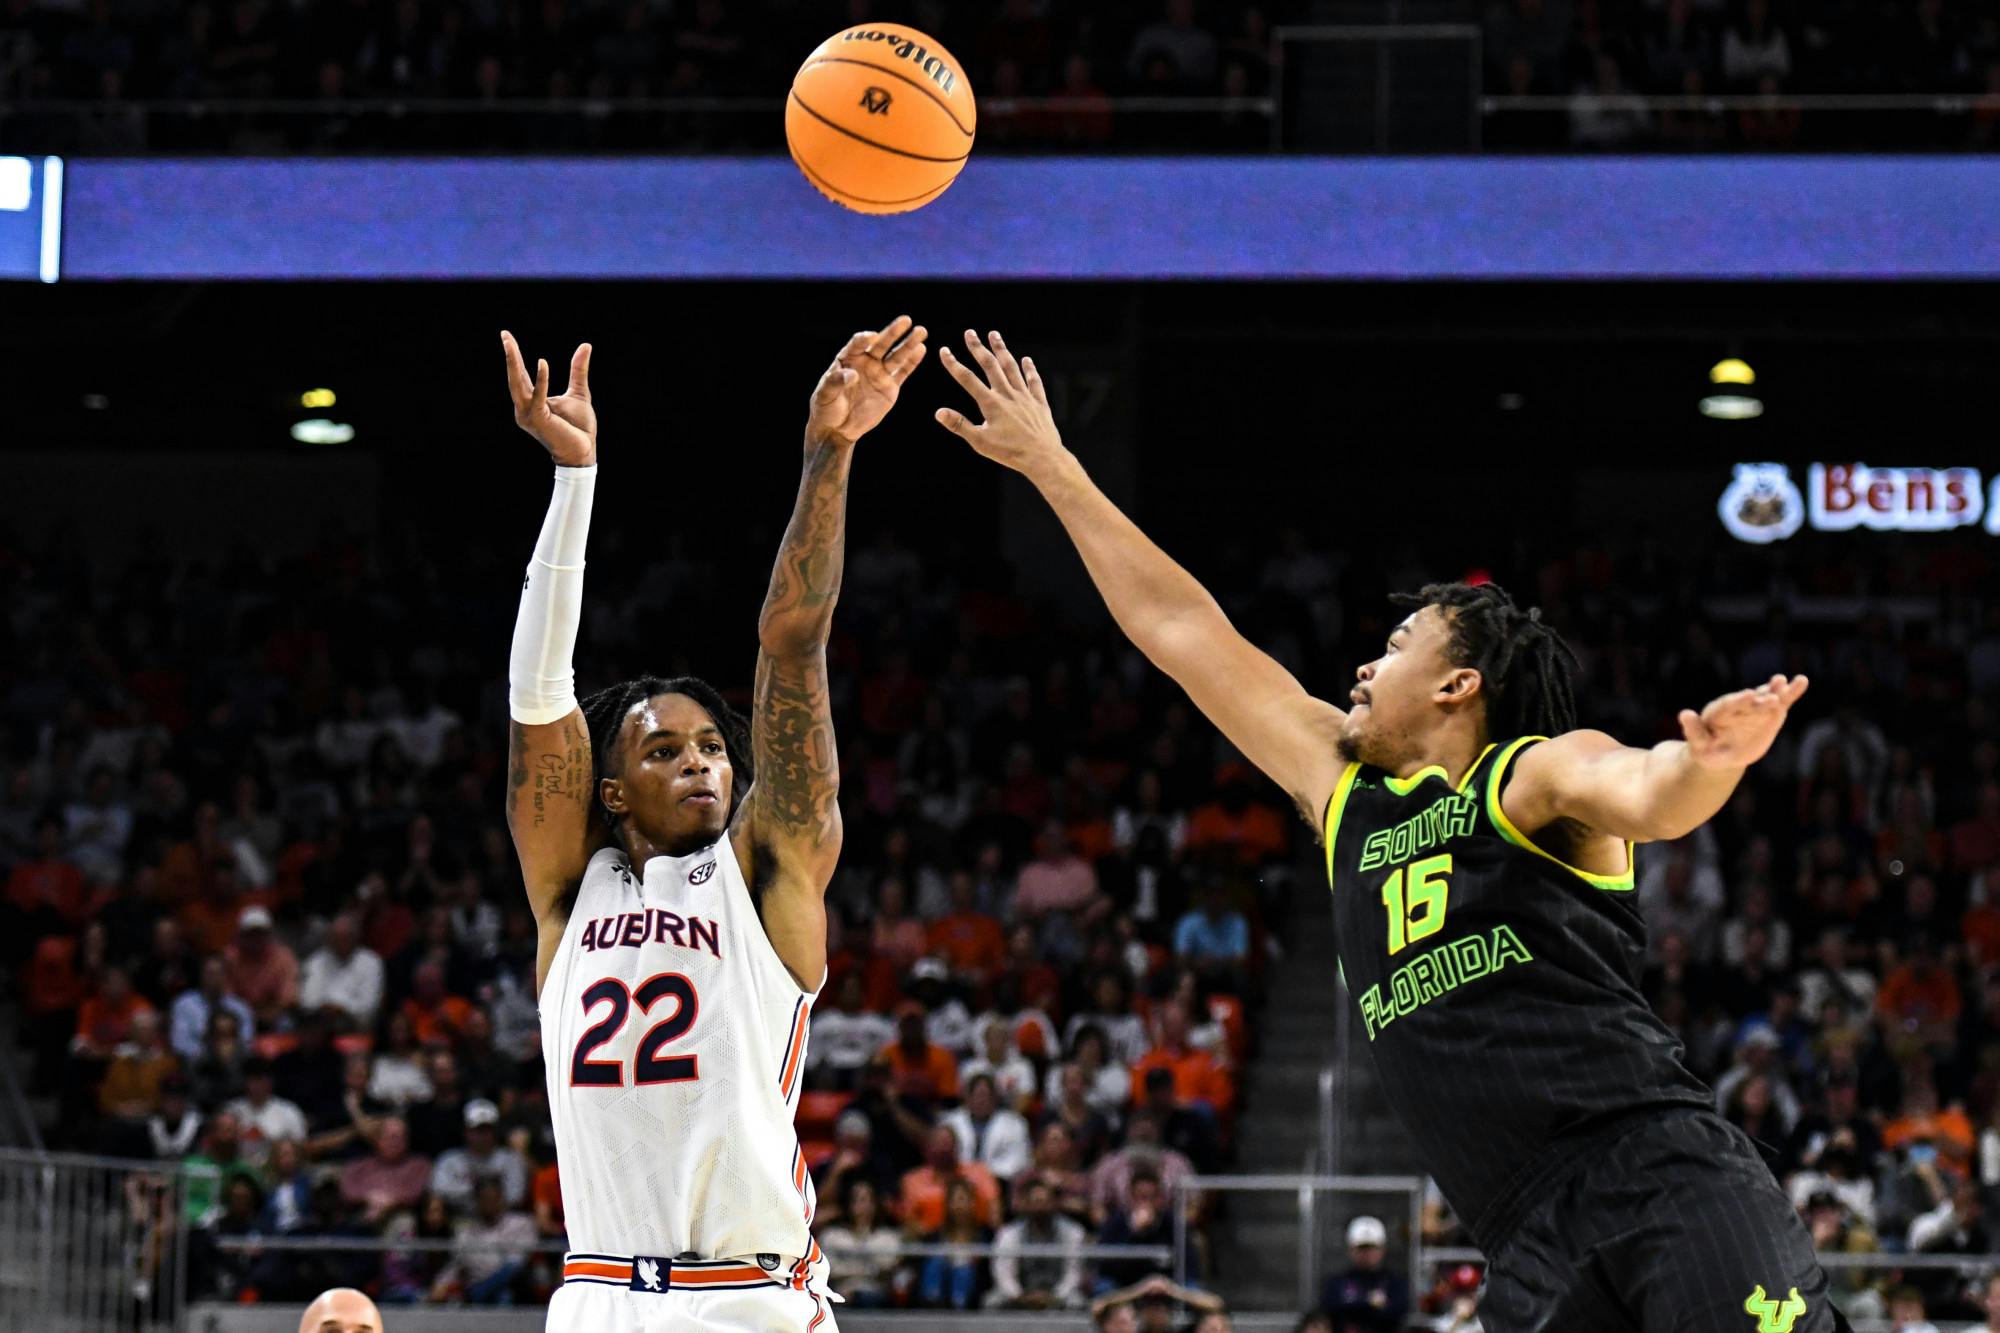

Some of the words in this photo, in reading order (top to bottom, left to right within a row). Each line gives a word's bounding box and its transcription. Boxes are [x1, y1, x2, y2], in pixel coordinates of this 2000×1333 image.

[844, 30, 955, 97] Wilson
[1820, 461, 1973, 518] Bens
[535, 753, 567, 799] God
[1382, 853, 1453, 956] 15
[1359, 924, 1534, 1042] FLORIDA
[570, 971, 699, 1087] 22
